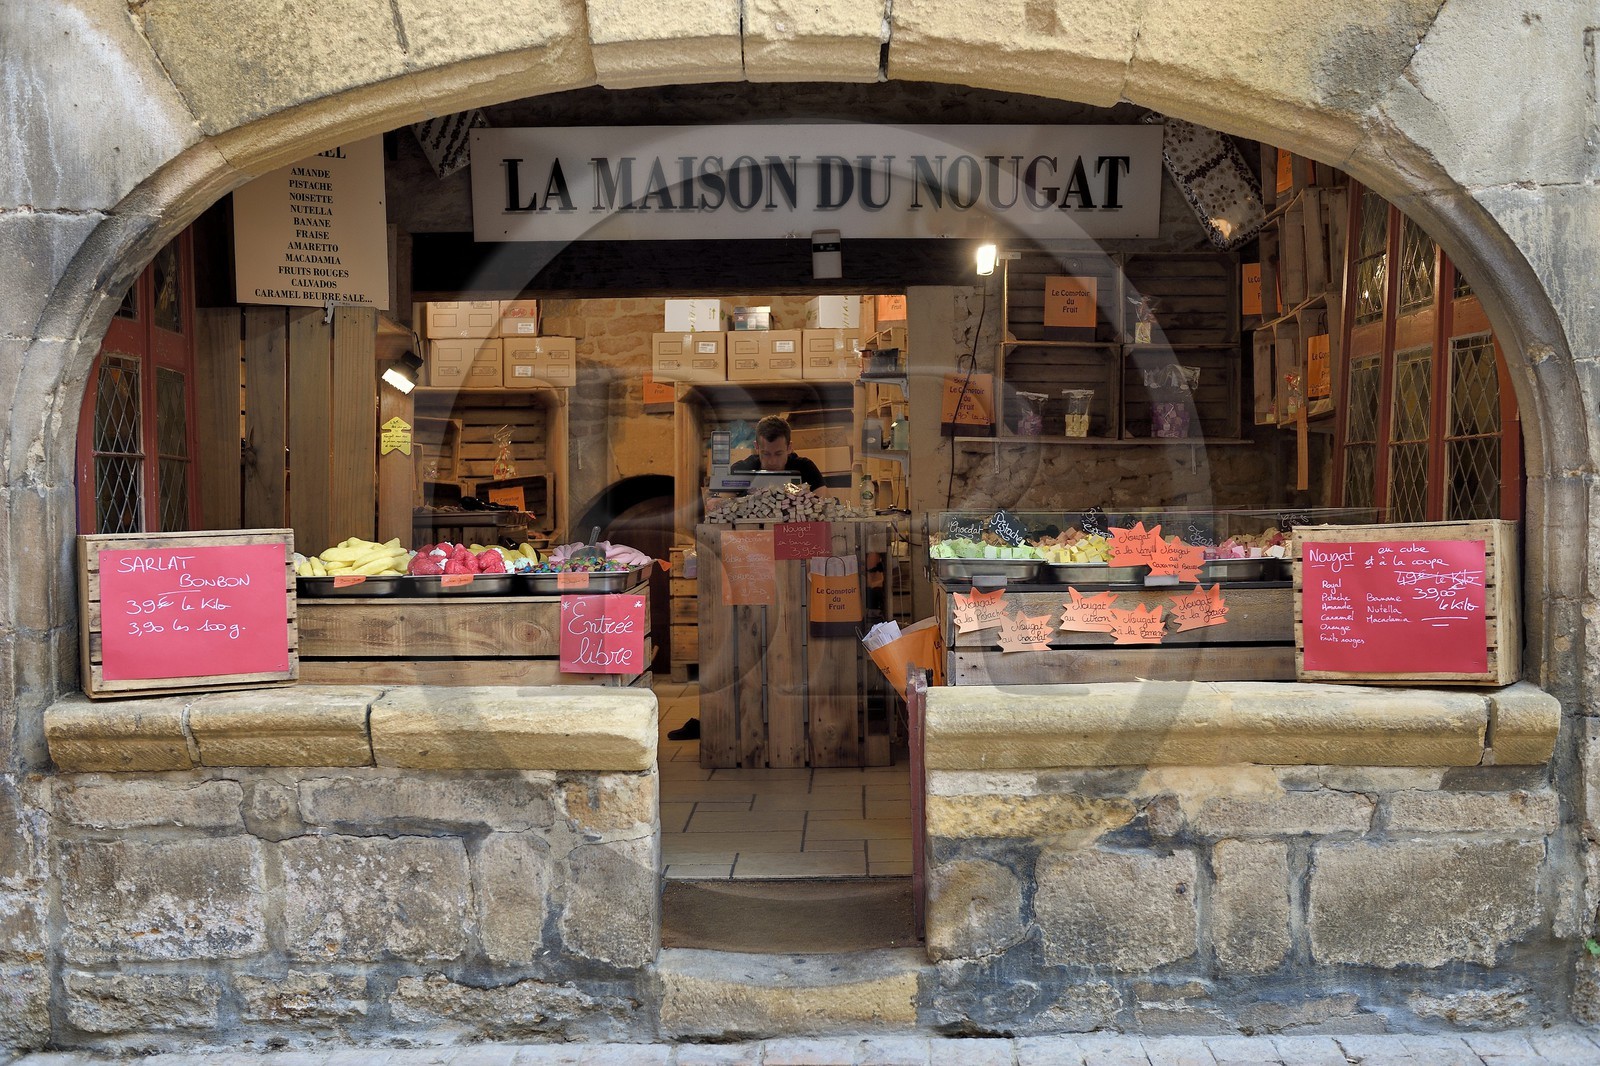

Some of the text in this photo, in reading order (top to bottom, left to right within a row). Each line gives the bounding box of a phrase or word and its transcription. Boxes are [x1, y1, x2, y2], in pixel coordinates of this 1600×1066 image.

[291, 168, 330, 178] AMANDE
[289, 180, 333, 191] PISTACHE
[501, 155, 1130, 213] LA MAISON DU NOUGAT
[289, 192, 333, 204] NOISETTE
[290, 205, 333, 216] NUTELLA
[293, 217, 331, 228] BANANE
[296, 230, 330, 239] FRAISE
[288, 242, 339, 252] AMARETTO
[286, 254, 341, 265] MACADAMIA
[278, 266, 349, 278] FRUITS ROUGES
[291, 279, 337, 288] CALVADOS
[255, 289, 302, 299] CARAMEL
[303, 291, 341, 301] BEURRE
[1052, 289, 1090, 297] Le Comptoir
[783, 523, 812, 538] Nougat
[990, 511, 1022, 545] Pistache
[1119, 531, 1151, 545] Nougat
[1123, 547, 1133, 555] la
[1161, 545, 1191, 559] Nougat
[1378, 543, 1429, 554] en cube
[117, 556, 195, 573] SARLAT
[1309, 547, 1355, 572] Nougat
[1365, 555, 1449, 570] et à la coupe
[179, 574, 250, 588] BONBON
[825, 586, 857, 595] Comptoir
[1322, 580, 1341, 595] Royal
[1179, 593, 1212, 612] Nougat
[1366, 593, 1402, 602] Banane
[181, 597, 195, 610] le
[201, 598, 232, 610] Kilo
[828, 603, 845, 611] Fruit
[959, 596, 996, 612] Nougat
[1071, 597, 1107, 615] Nougat
[1322, 603, 1353, 611] Amande
[1438, 597, 1479, 611] le Kilo
[1367, 605, 1402, 614] Nutella
[568, 601, 634, 635] Entrée
[963, 614, 974, 623] la
[1081, 612, 1111, 622] Citron
[1122, 613, 1157, 627] Nougat
[1180, 612, 1187, 621] à
[1189, 610, 1201, 619] la
[1320, 612, 1354, 621] Caramel
[1366, 615, 1411, 623] Macadamia
[128, 621, 165, 637] 3,90
[173, 619, 190, 631] les
[1011, 620, 1044, 635] Nougat
[1117, 627, 1123, 635] à
[1125, 626, 1138, 636] la
[1320, 623, 1351, 633] Orange
[1017, 631, 1048, 642] Chocolat
[1320, 634, 1365, 648] Fruits rouges
[572, 637, 632, 665] libre
